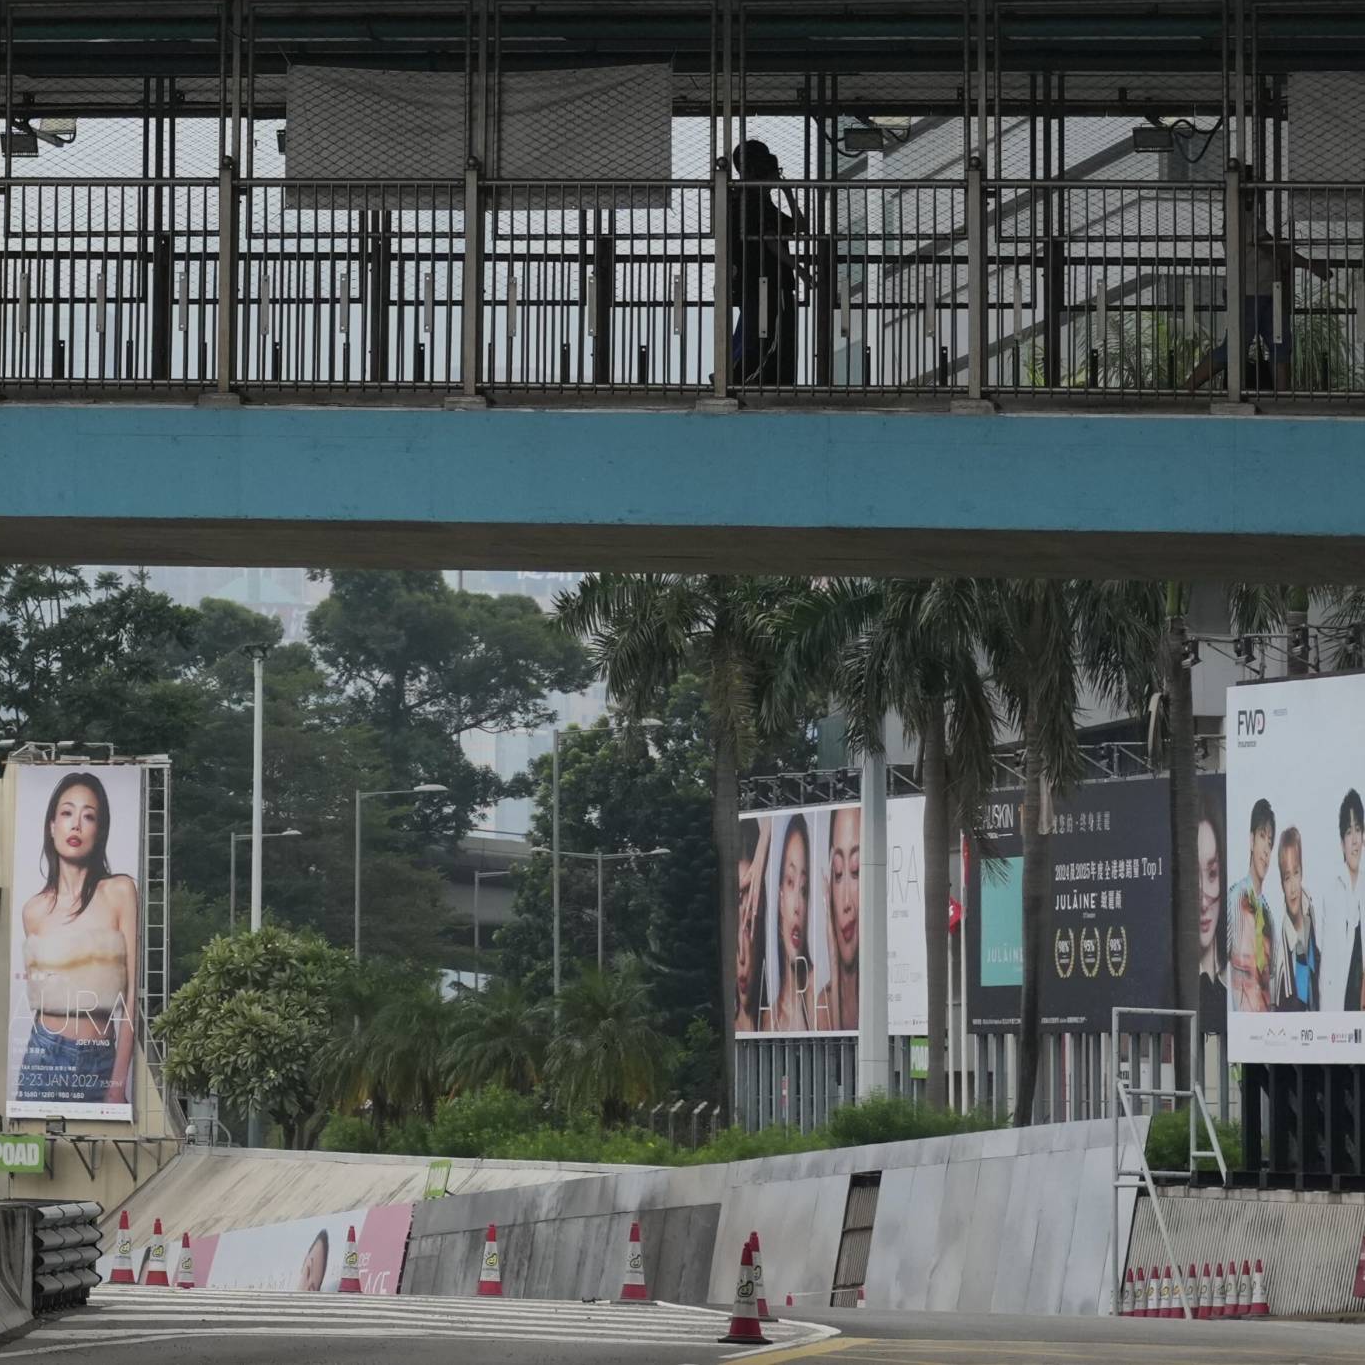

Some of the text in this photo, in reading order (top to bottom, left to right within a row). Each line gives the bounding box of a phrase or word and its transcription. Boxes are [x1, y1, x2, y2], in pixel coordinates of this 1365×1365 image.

[1237, 709, 1266, 736] FWD
[1141, 857, 1157, 881] Top
[1158, 856, 1163, 876] 1
[9, 989, 135, 1036] AURA
[92, 1039, 110, 1047] YUNG
[45, 1073, 69, 1087] JAN
[71, 1073, 99, 1088] 2027
